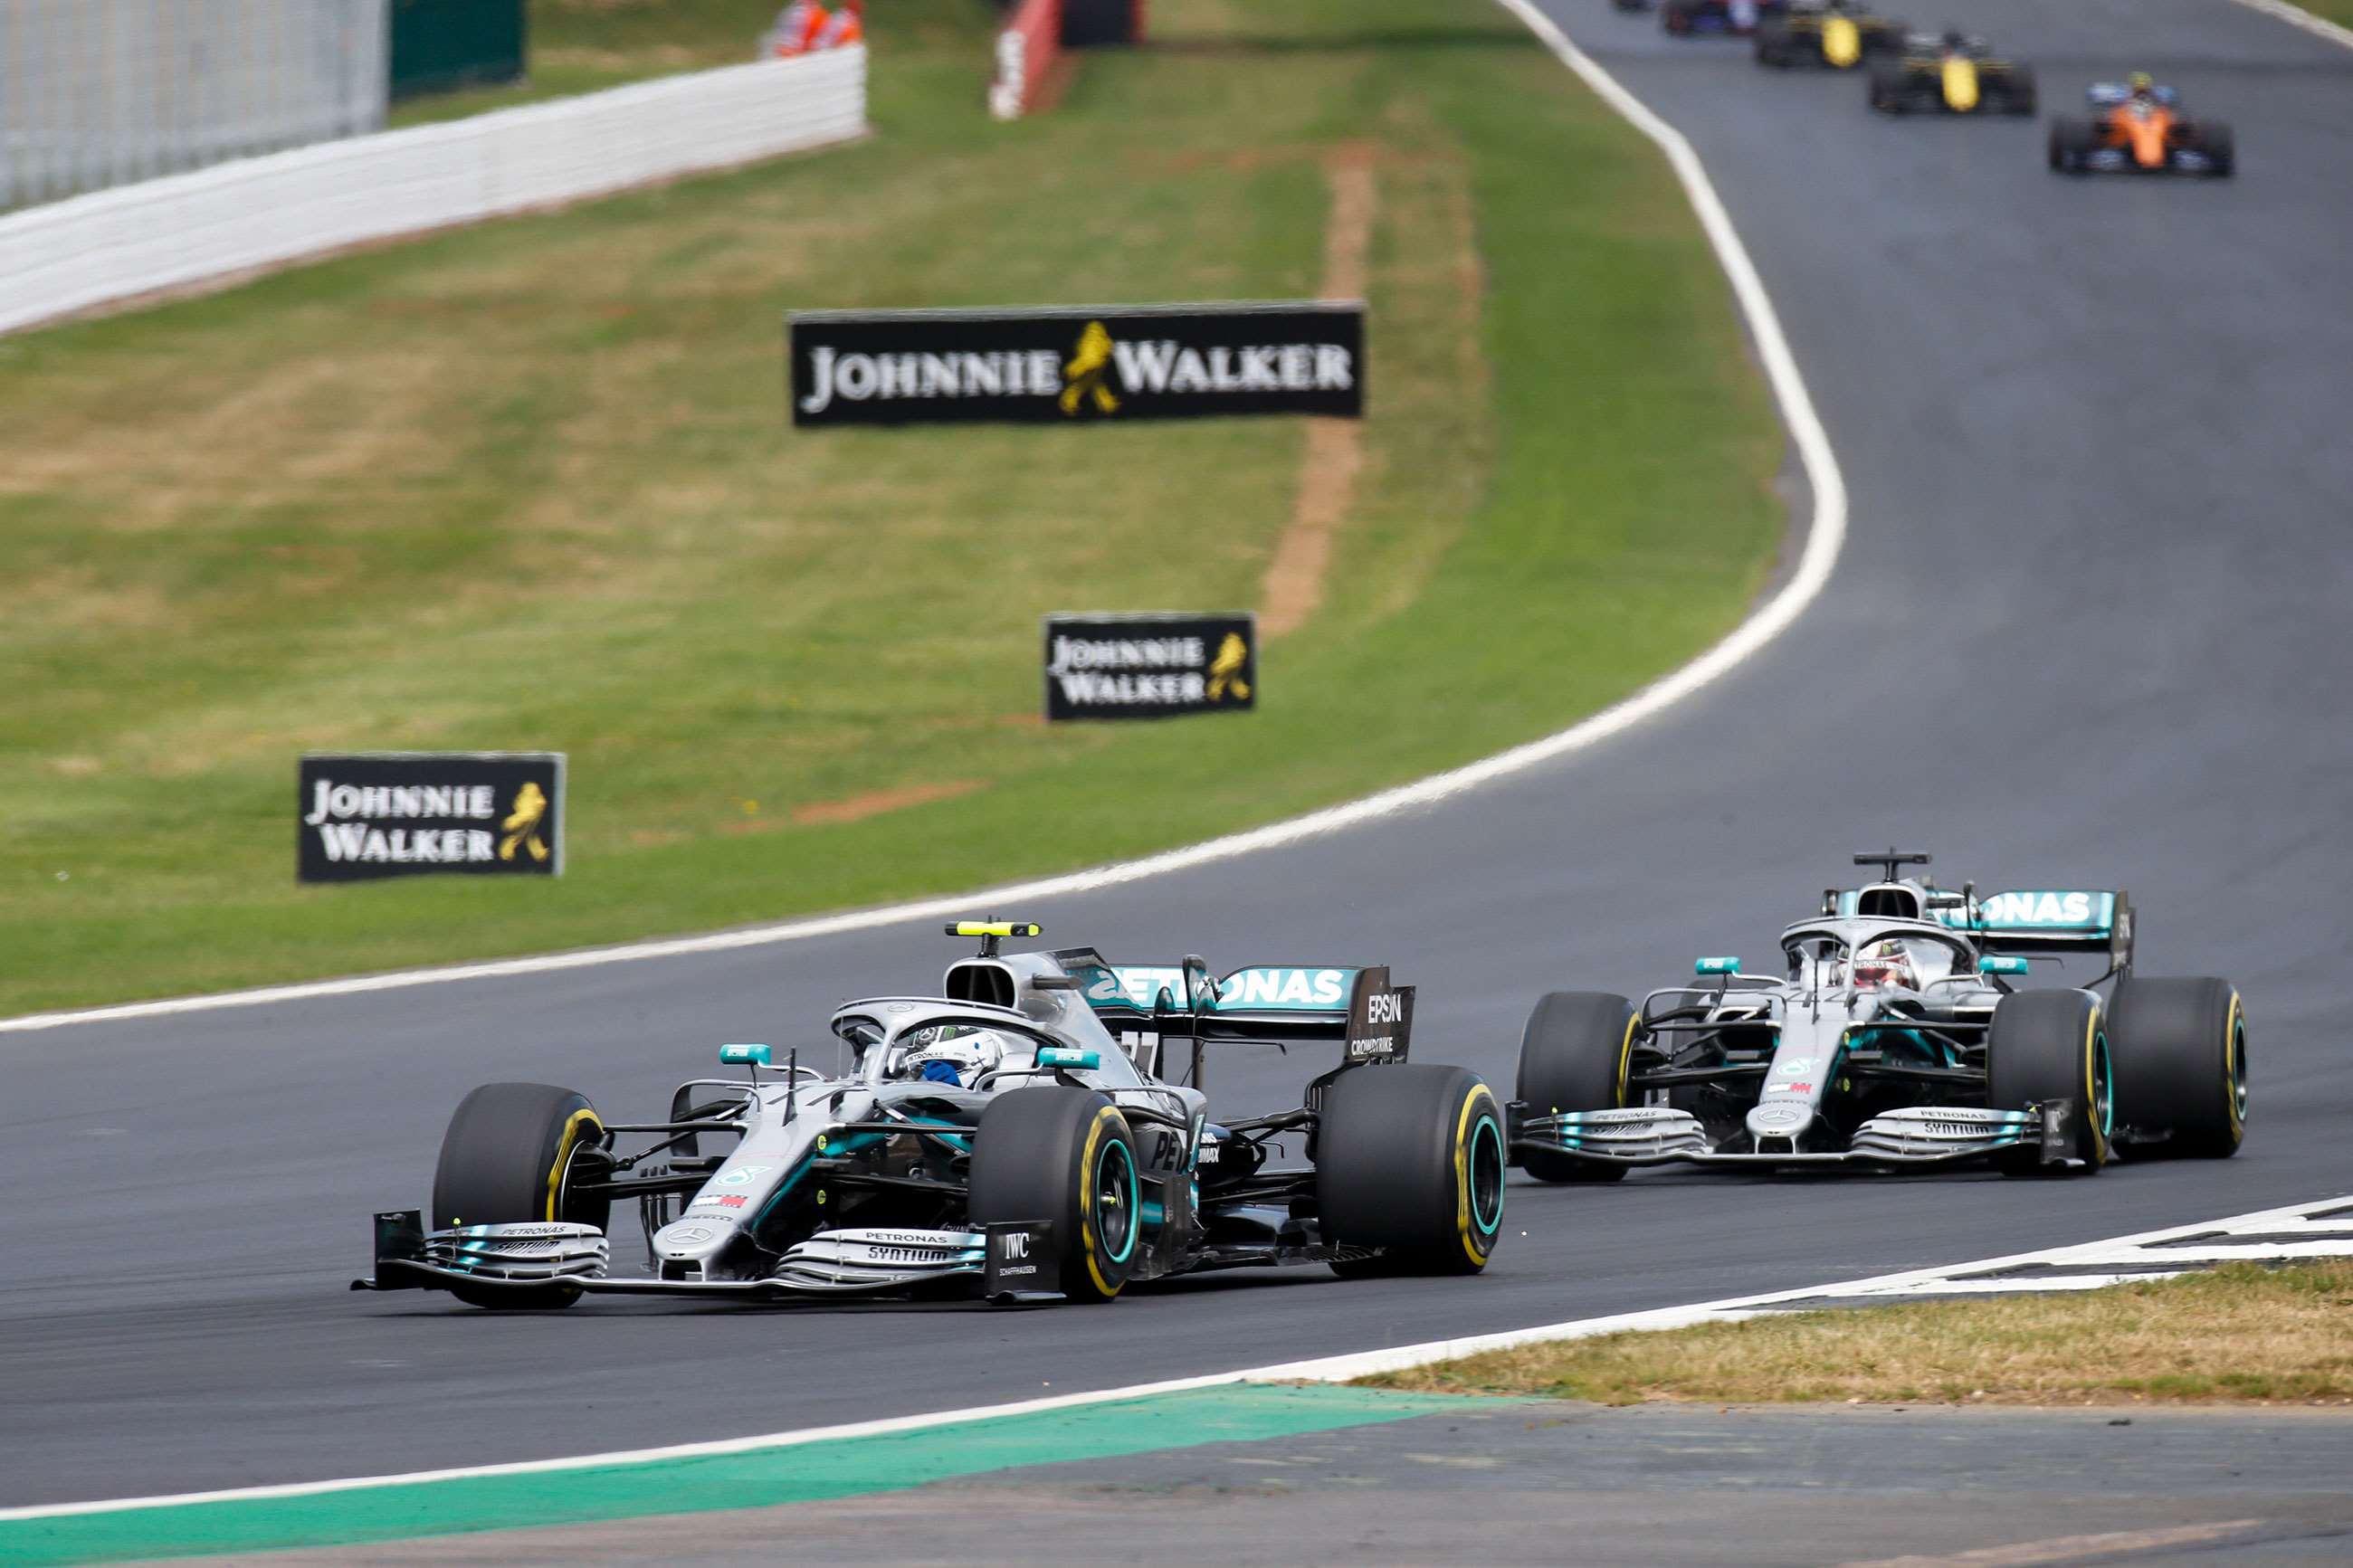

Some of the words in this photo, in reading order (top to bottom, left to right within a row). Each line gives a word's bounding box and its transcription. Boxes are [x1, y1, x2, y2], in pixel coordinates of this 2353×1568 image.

[800, 346, 1063, 414] JOHNNIE
[1112, 340, 1354, 392] WALKER
[1047, 635, 1205, 676] JOHNNIE
[1056, 672, 1205, 705] WALKER
[304, 779, 495, 825] JOHNNIE
[319, 822, 495, 862] WALKER
[501, 1225, 567, 1236] PETRONAS
[865, 1231, 948, 1244] PETRONAS
[1005, 1232, 1030, 1259] IWC
[869, 1246, 948, 1262] SYNTIUM
